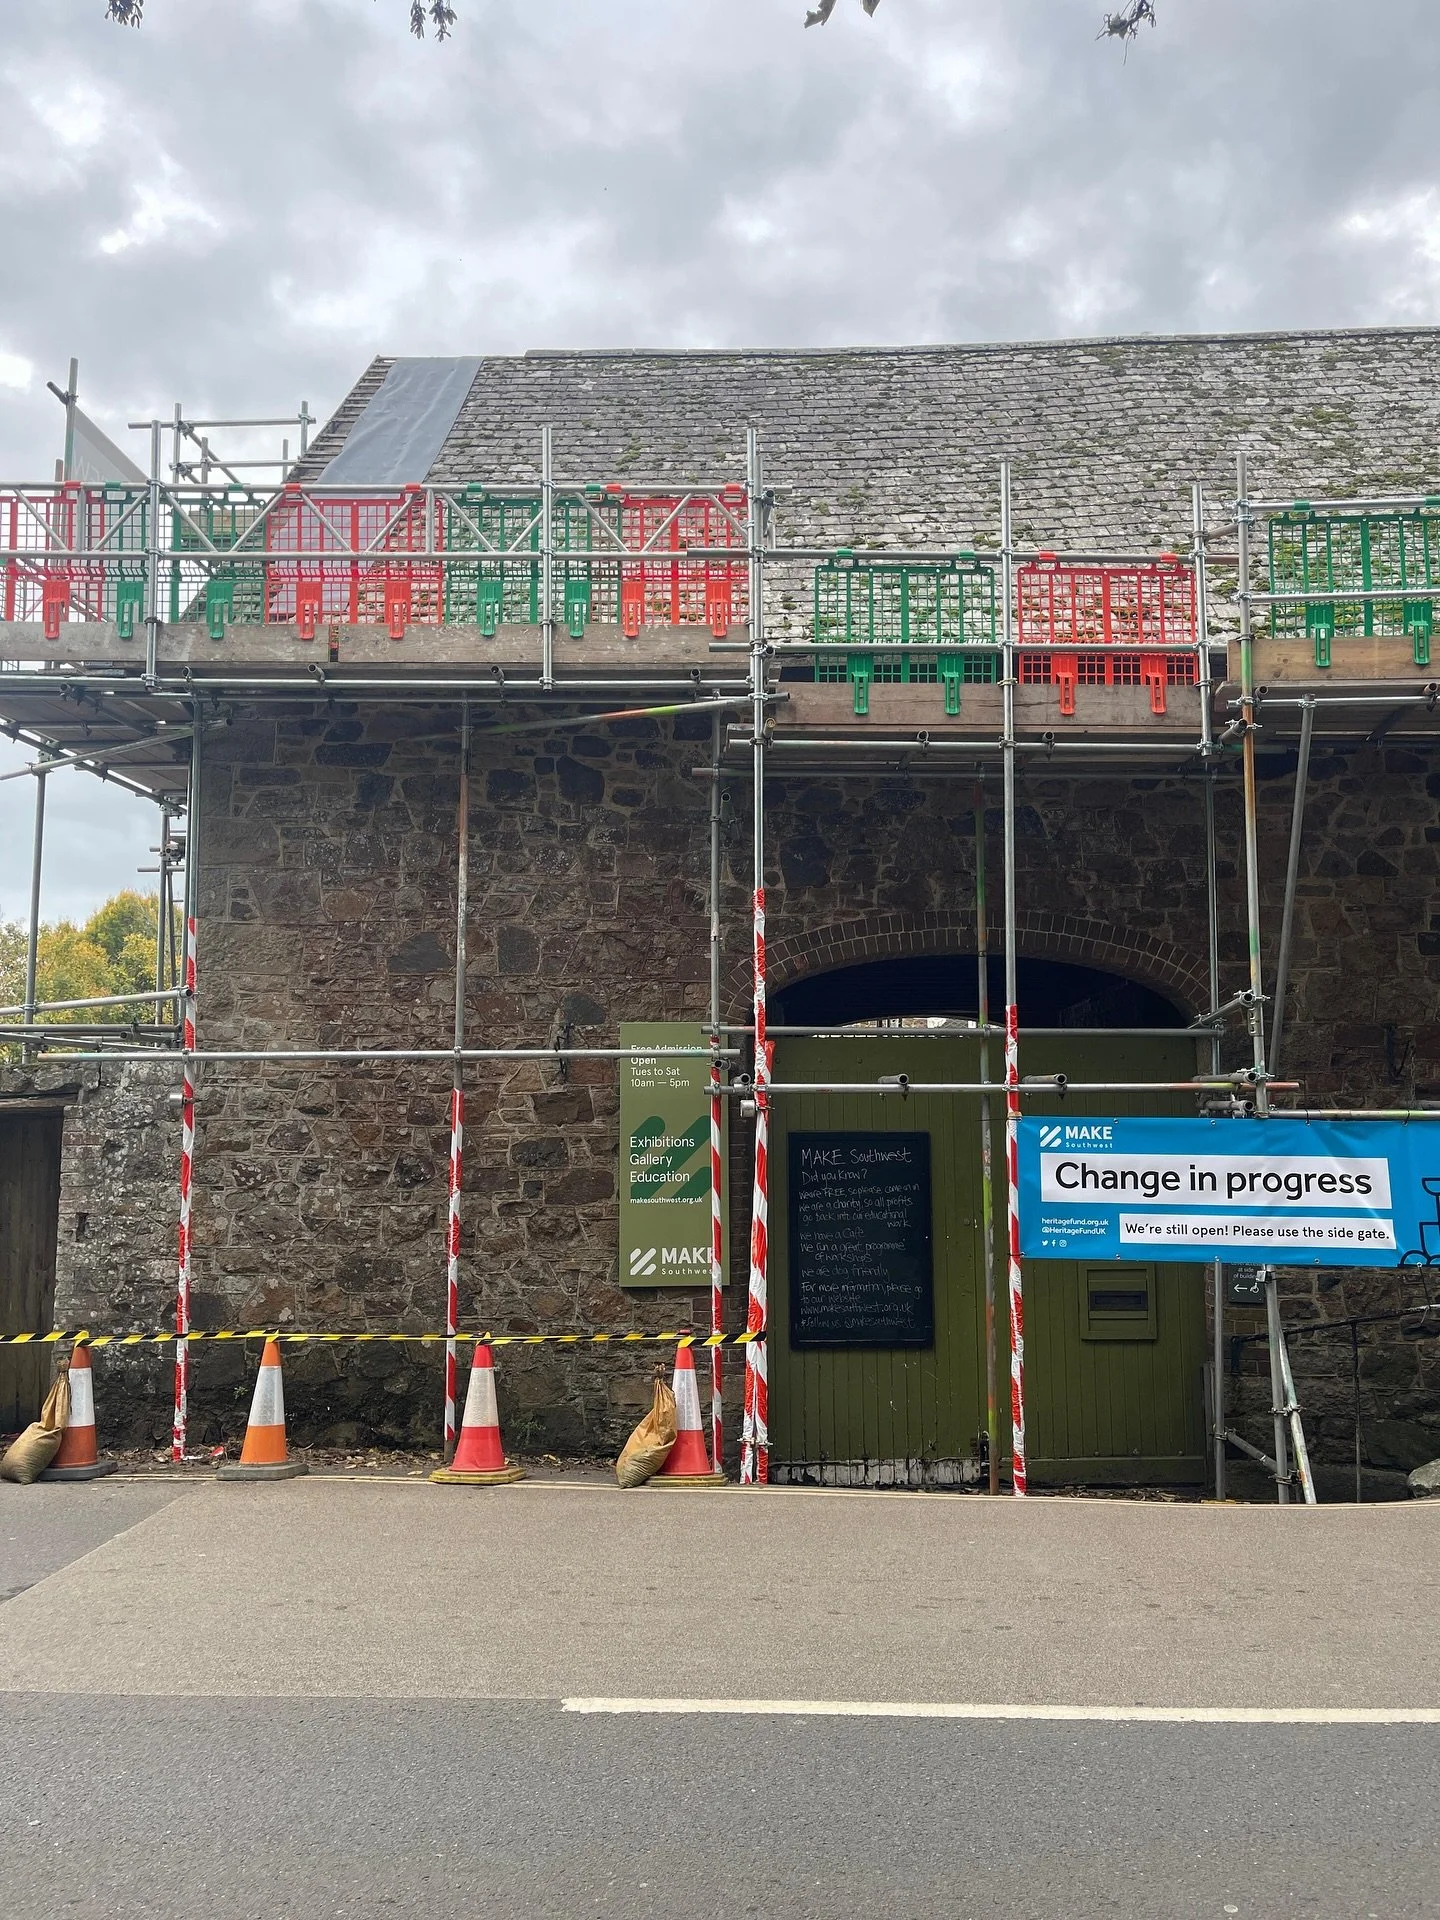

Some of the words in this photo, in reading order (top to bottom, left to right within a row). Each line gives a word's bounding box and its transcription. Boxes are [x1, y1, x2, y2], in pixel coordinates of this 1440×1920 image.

[630, 1057, 657, 1065] Open
[630, 1067, 652, 1076] Tues
[653, 1067, 664, 1076] to
[665, 1067, 681, 1076] Sat
[630, 1078, 655, 1087] 10am
[669, 1078, 690, 1088] 5pm
[1065, 1126, 1113, 1140] MAKE
[630, 1136, 695, 1148] Exhibitions
[629, 1154, 673, 1168] Gallery
[801, 1148, 846, 1168] MAKE
[850, 1146, 912, 1164] Southwest
[630, 1171, 690, 1183] Education
[801, 1170, 819, 1186] Did
[820, 1172, 837, 1189] you
[1055, 1161, 1181, 1198] Change
[1189, 1164, 1217, 1192] in
[1226, 1171, 1373, 1201] progress
[630, 1196, 703, 1205] makesouthwest.org.uk
[874, 1197, 884, 1207] all
[1041, 1217, 1109, 1227] heritagefund.org.uk
[1041, 1226, 1106, 1235] @HeritageFundUK
[1166, 1224, 1188, 1235] still
[1191, 1225, 1229, 1238] open!
[1233, 1225, 1274, 1238] Please
[1277, 1228, 1299, 1237] use
[1302, 1227, 1324, 1238] the
[1327, 1227, 1354, 1239] side
[1357, 1230, 1390, 1242] gate.
[801, 1281, 817, 1293] For
